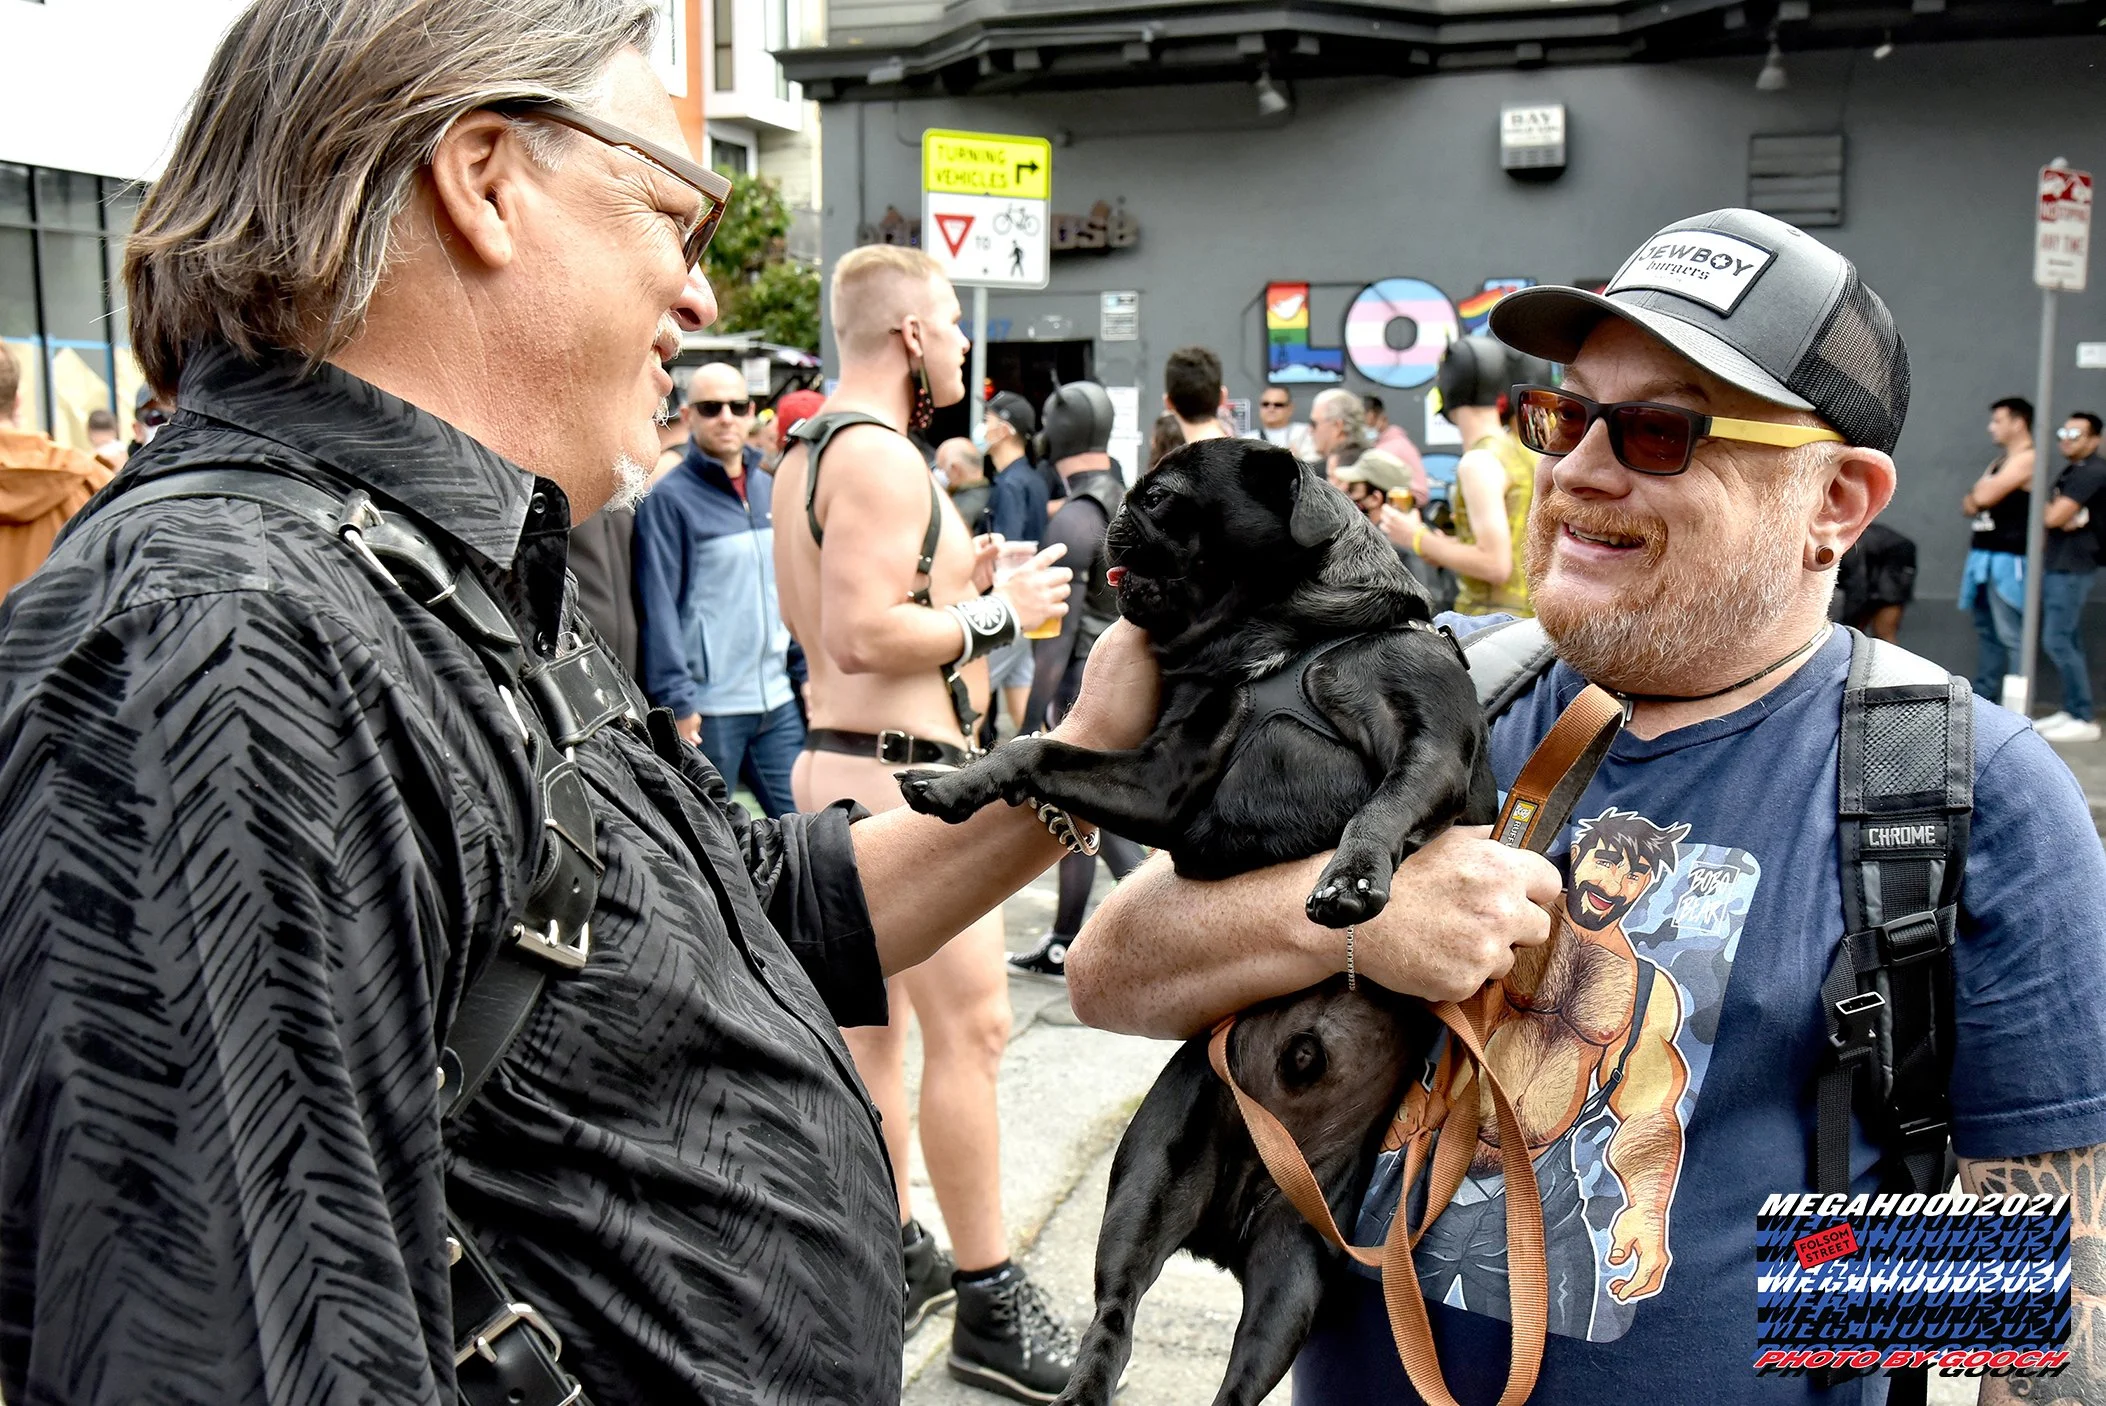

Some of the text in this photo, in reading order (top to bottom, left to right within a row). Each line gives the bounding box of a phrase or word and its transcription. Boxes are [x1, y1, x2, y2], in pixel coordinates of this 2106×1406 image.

[937, 144, 1006, 165] TURNING
[935, 168, 1007, 188] VEHICLES
[975, 235, 992, 251] TO
[1638, 244, 1754, 276] JEWBOY
[1646, 260, 1710, 280] burgers
[1868, 825, 1936, 846] CHROME
